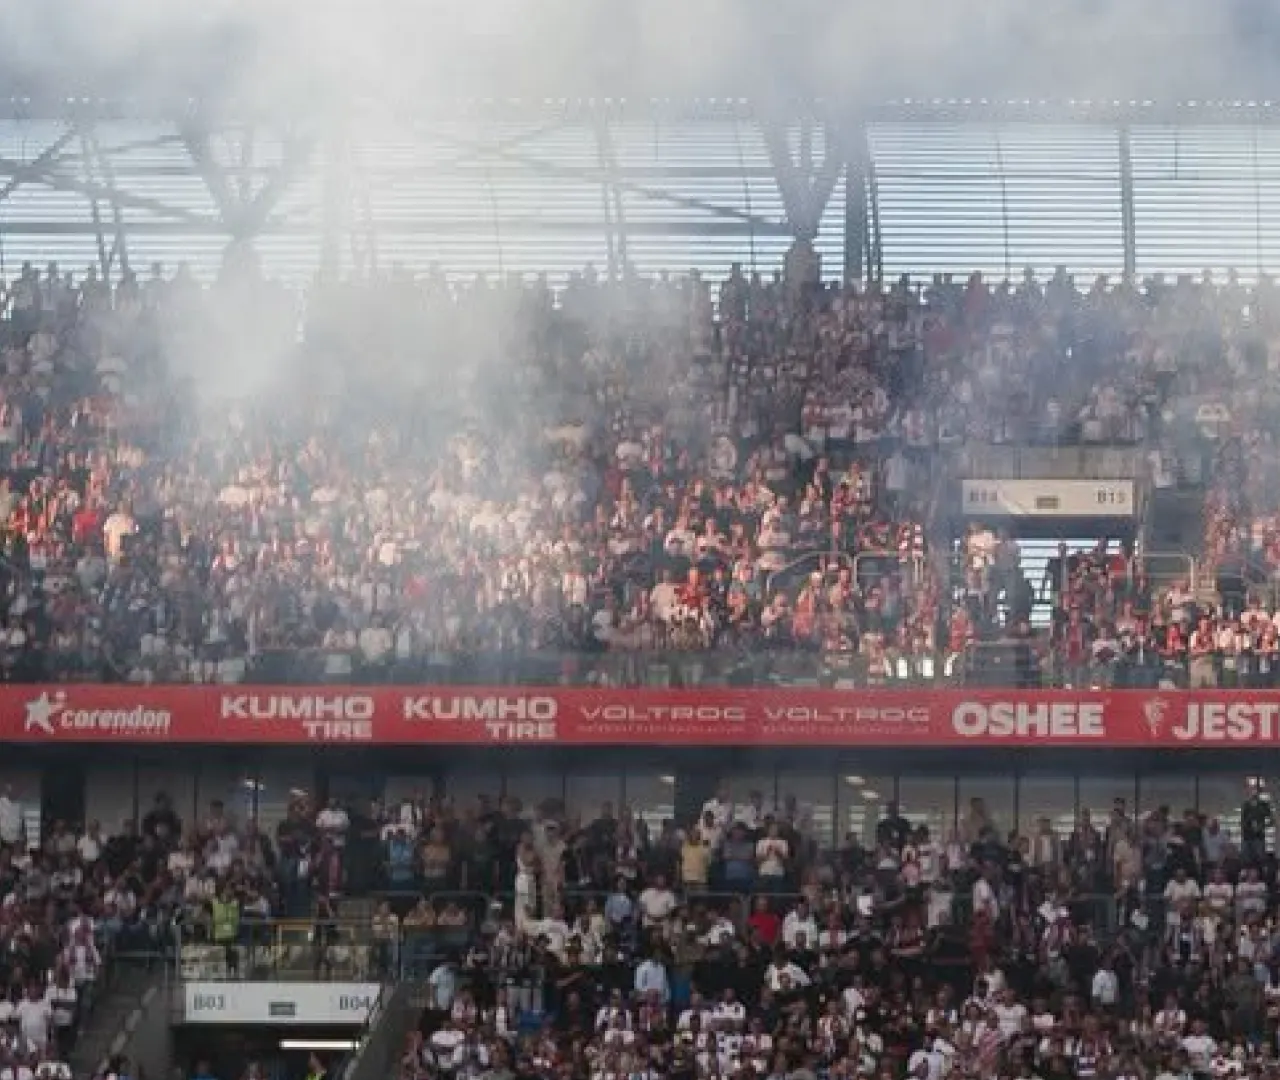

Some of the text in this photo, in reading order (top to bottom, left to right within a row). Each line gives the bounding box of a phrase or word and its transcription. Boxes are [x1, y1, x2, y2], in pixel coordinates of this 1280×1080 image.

[61, 704, 171, 728] corendon
[221, 695, 374, 719] KUMHO
[403, 696, 557, 719] KUMHO
[302, 720, 373, 738] TIRE
[486, 721, 556, 739] TIRE
[951, 701, 1105, 737] OSHEE
